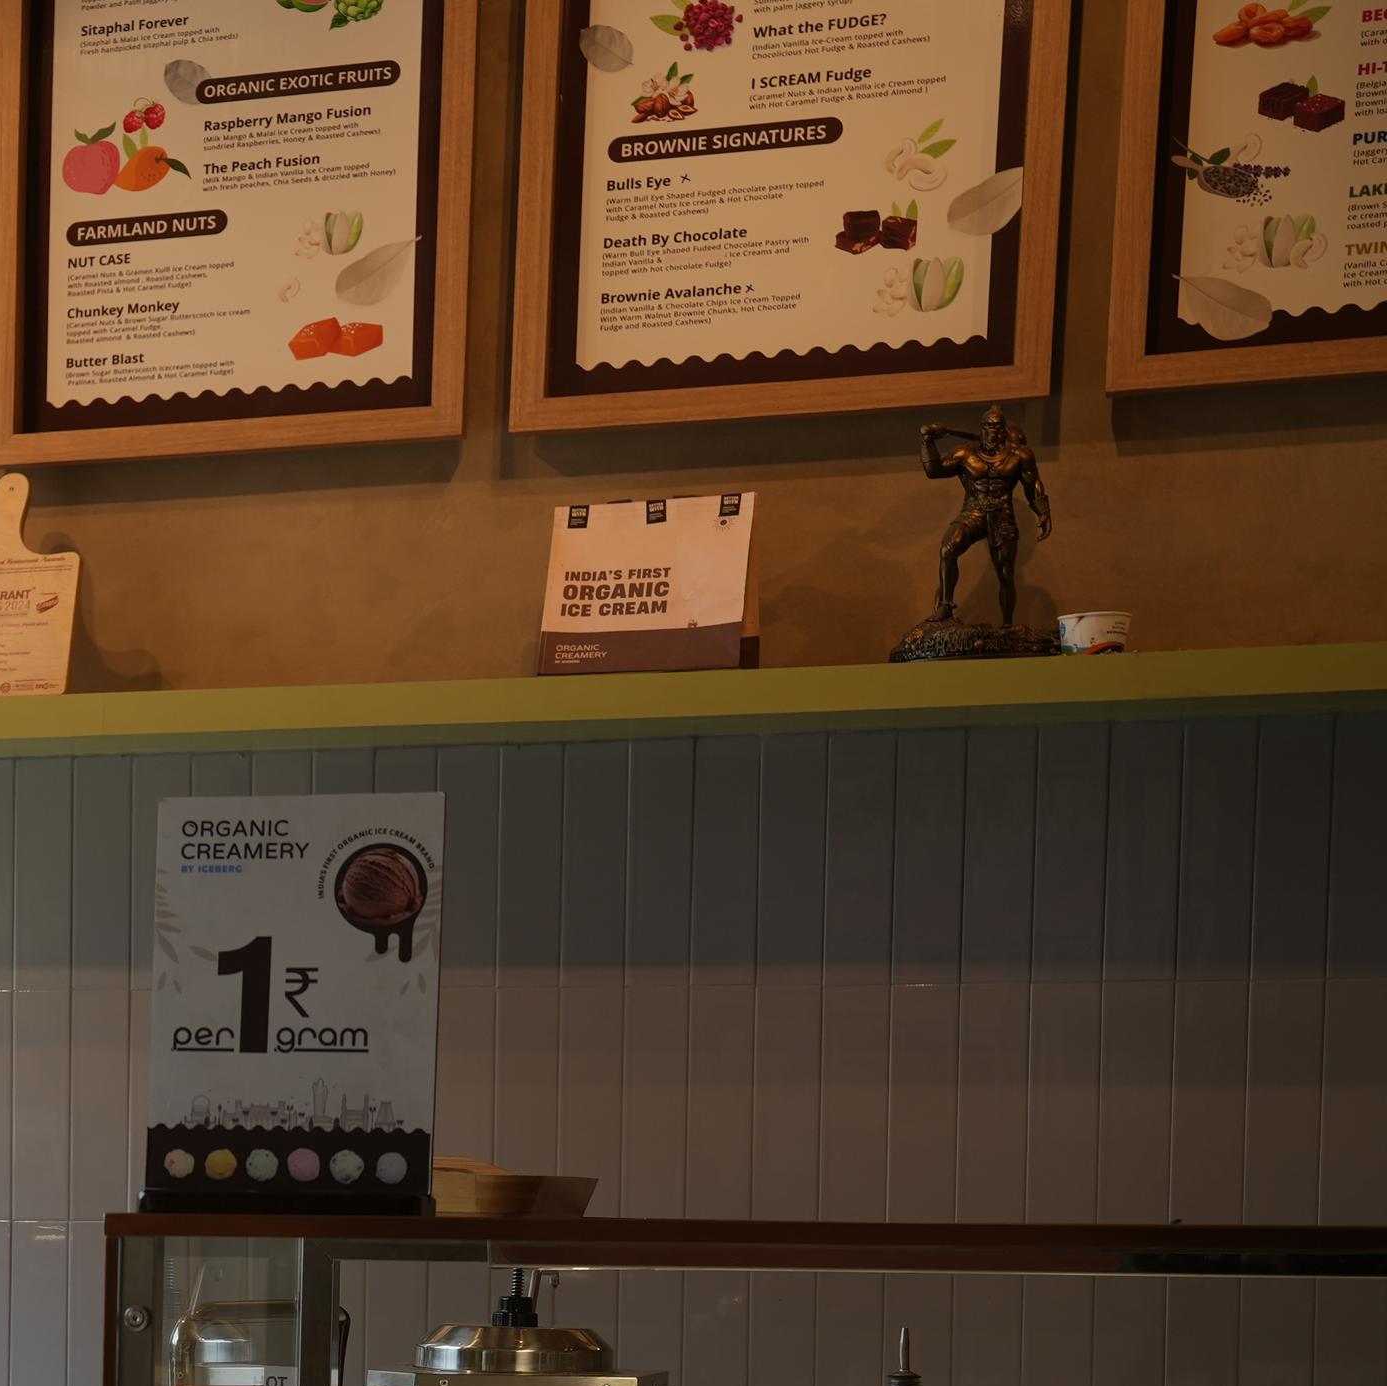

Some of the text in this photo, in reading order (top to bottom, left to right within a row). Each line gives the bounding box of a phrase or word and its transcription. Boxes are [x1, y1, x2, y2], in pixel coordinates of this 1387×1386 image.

[81, 15, 189, 37] Sitaphal Forever
[753, 12, 887, 39] What the FUDGE?
[204, 66, 393, 98] ORGANIC EXOTIC FRUITS
[751, 66, 872, 90] I SCREAM Fudge
[787, 89, 807, 99] Nuts
[817, 85, 843, 95] Indian
[844, 82, 872, 92] Vanilla
[888, 79, 915, 88] Cream
[916, 75, 946, 85] topped
[204, 104, 372, 132] Raspberry Mango Fusion
[621, 125, 827, 158] BROWNIE SIGNATURES
[203, 153, 321, 175] The Peach Fusion
[606, 176, 672, 192] Bulls Eye
[77, 215, 217, 240] FARMLAND NUTS
[603, 227, 748, 250] Death By Chocolate
[67, 252, 131, 269] NUT CASE
[601, 283, 742, 305] Brownie Avalanche
[67, 300, 180, 319] Chunkey Monkey
[66, 353, 144, 369] Butter Blast
[628, 567, 672, 580] FIRST
[563, 581, 670, 601] ORGANIC
[561, 600, 668, 617] ICE CREAM
[555, 651, 608, 660] CREAMERY
[556, 643, 600, 652] ORGANIC
[182, 820, 289, 837] ORGANIC
[337, 829, 374, 850] ORGANIC
[389, 828, 417, 844] CREAM
[181, 843, 310, 860] CREAMERY
[181, 865, 243, 873] BY ICEBERG
[218, 936, 272, 1053] 1
[172, 1027, 369, 1054] per gram
